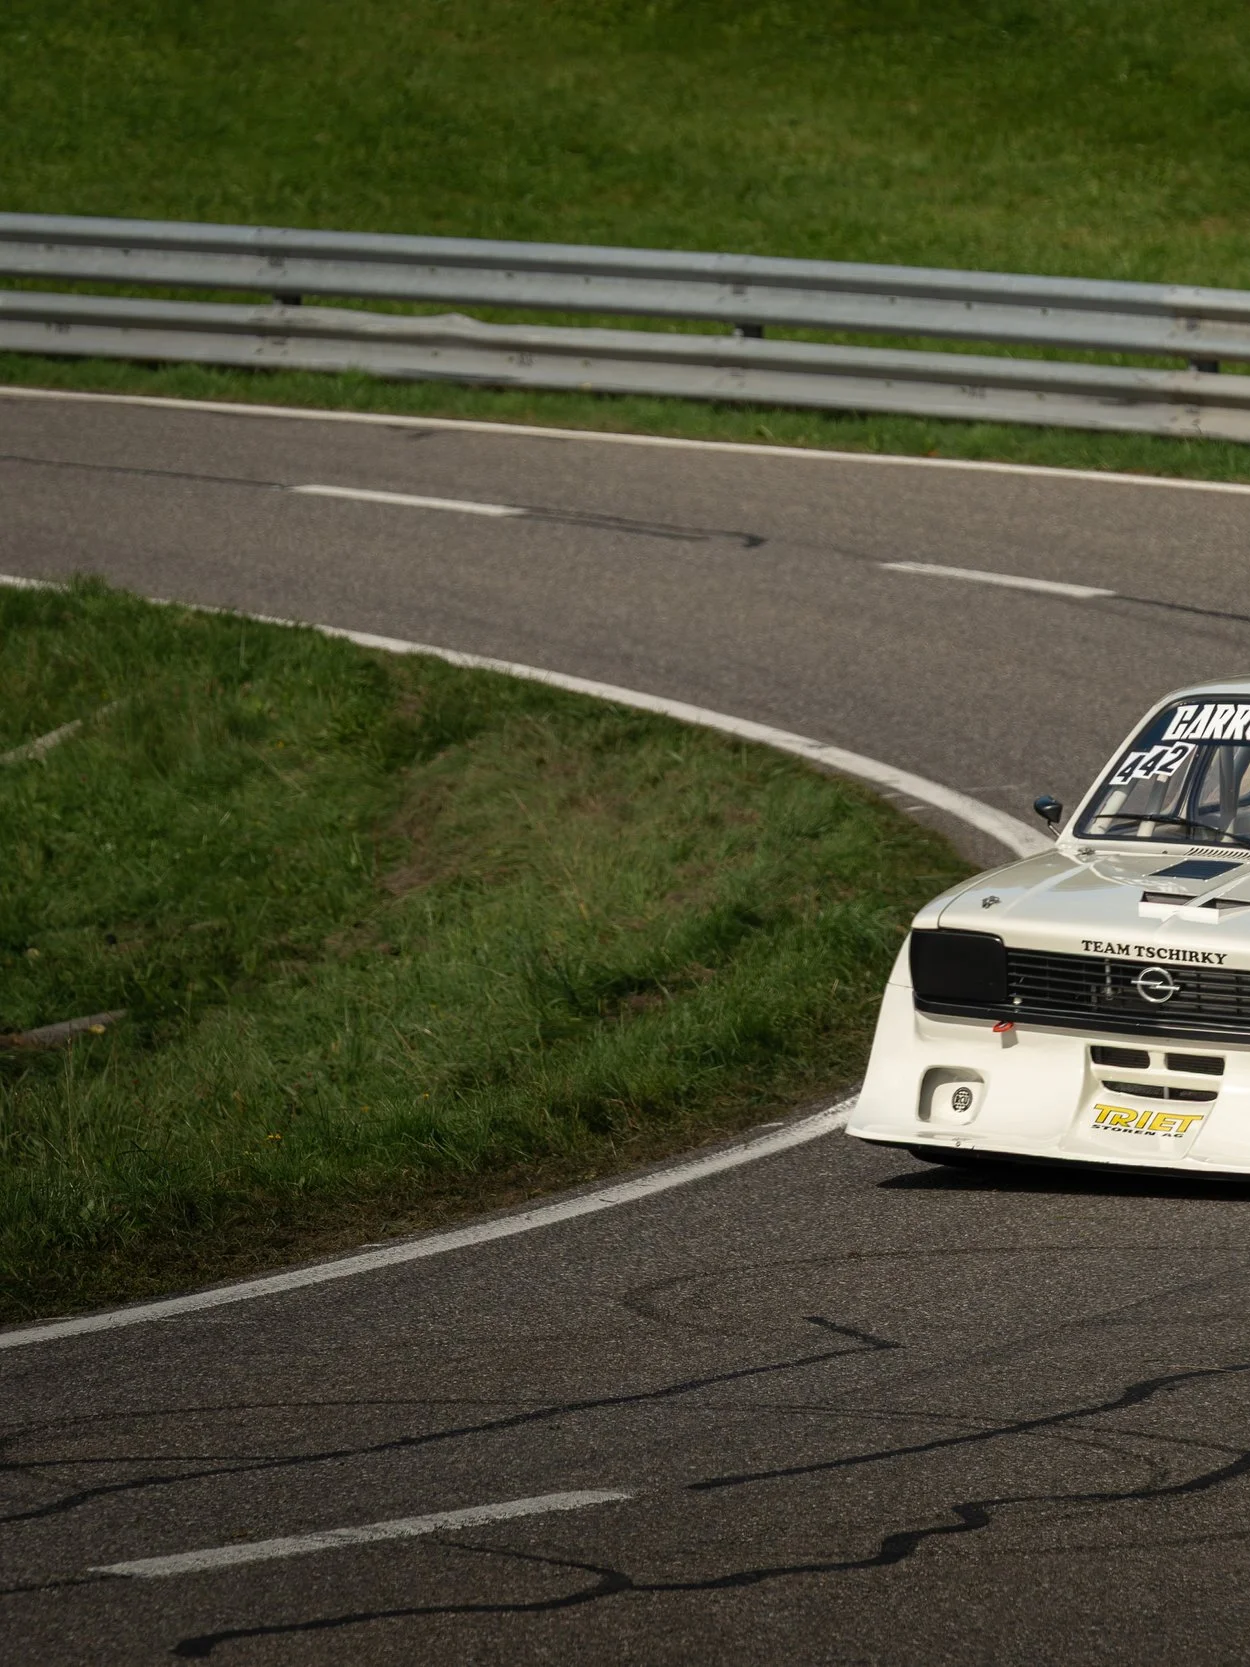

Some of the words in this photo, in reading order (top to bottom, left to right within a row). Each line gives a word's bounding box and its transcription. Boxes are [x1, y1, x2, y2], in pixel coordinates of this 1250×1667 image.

[1116, 744, 1189, 783] 442
[1081, 940, 1131, 956] TEAM
[1134, 945, 1228, 965] TSCHIRKY
[1091, 1124, 1156, 1136] STOREN
[1094, 1103, 1205, 1133] TRIET
